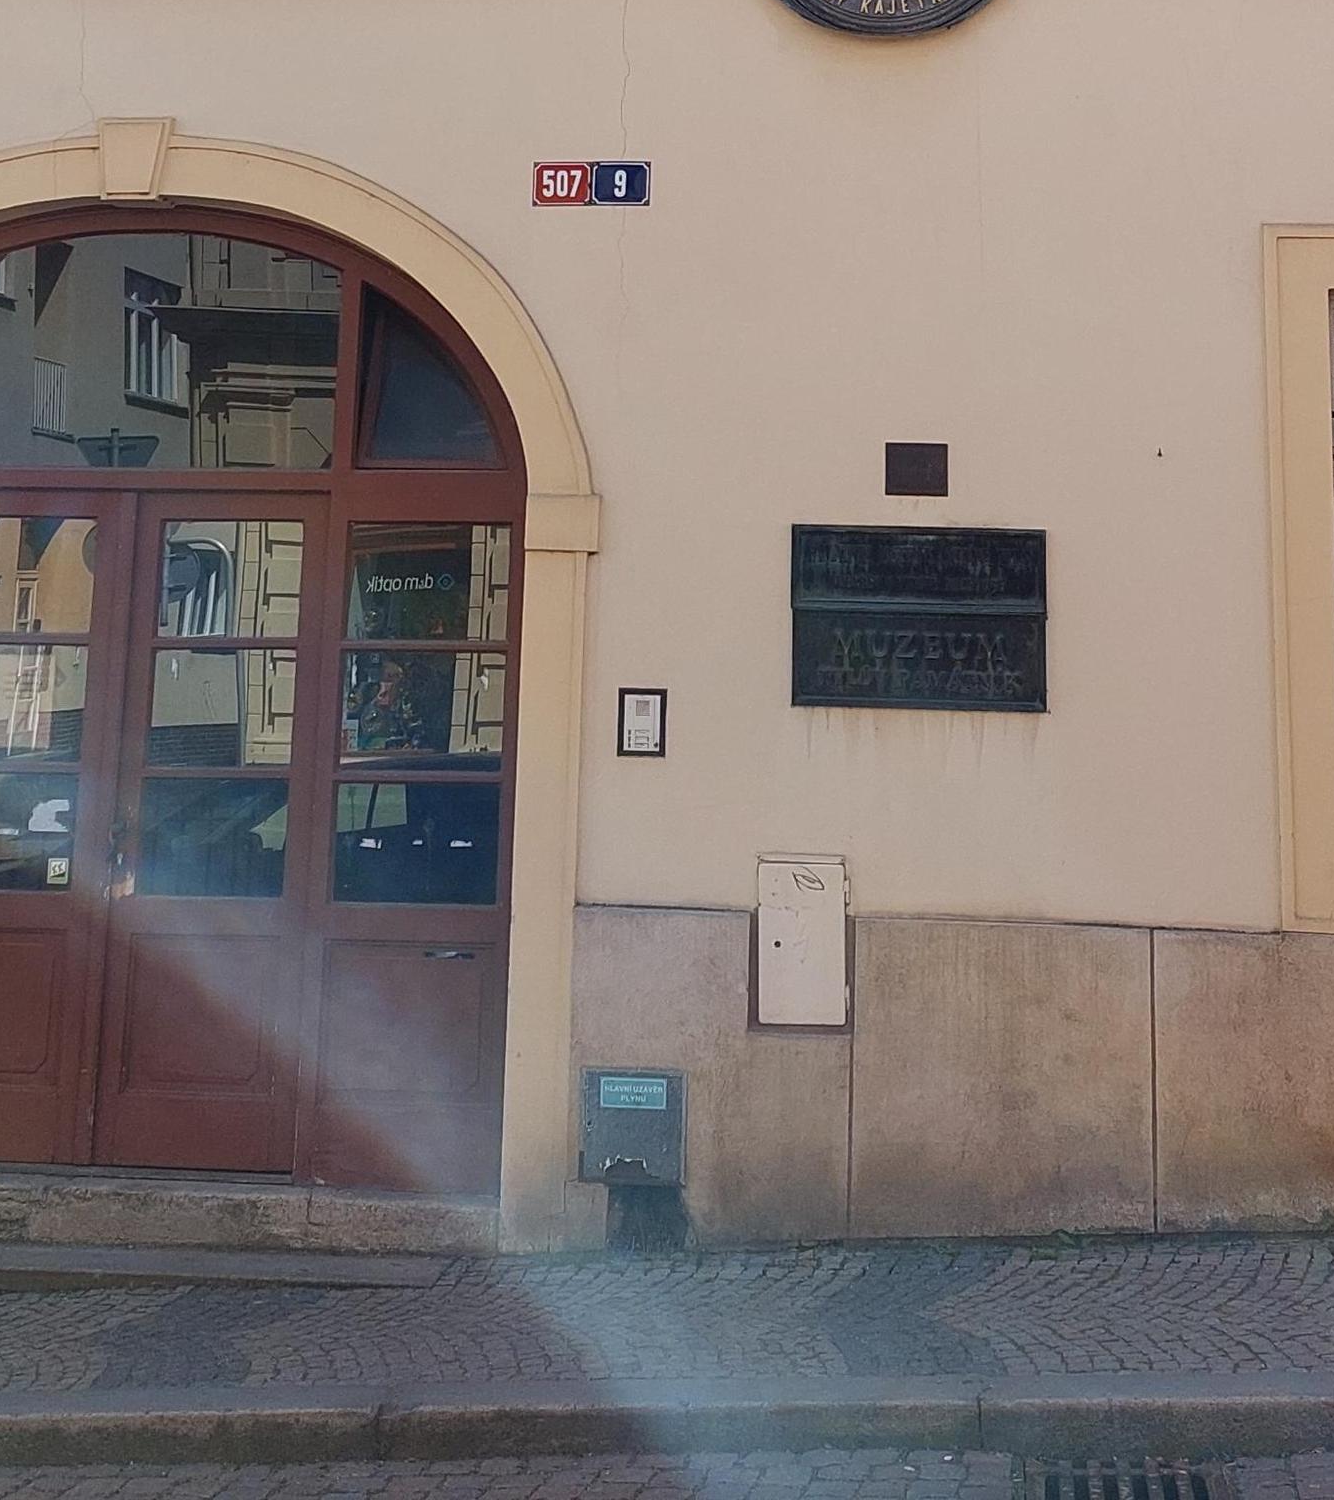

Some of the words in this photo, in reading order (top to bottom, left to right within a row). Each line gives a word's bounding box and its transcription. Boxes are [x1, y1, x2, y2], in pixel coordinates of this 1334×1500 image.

[542, 169, 582, 198] 507
[613, 169, 627, 198] 9
[834, 629, 1007, 660] MUZEUM
